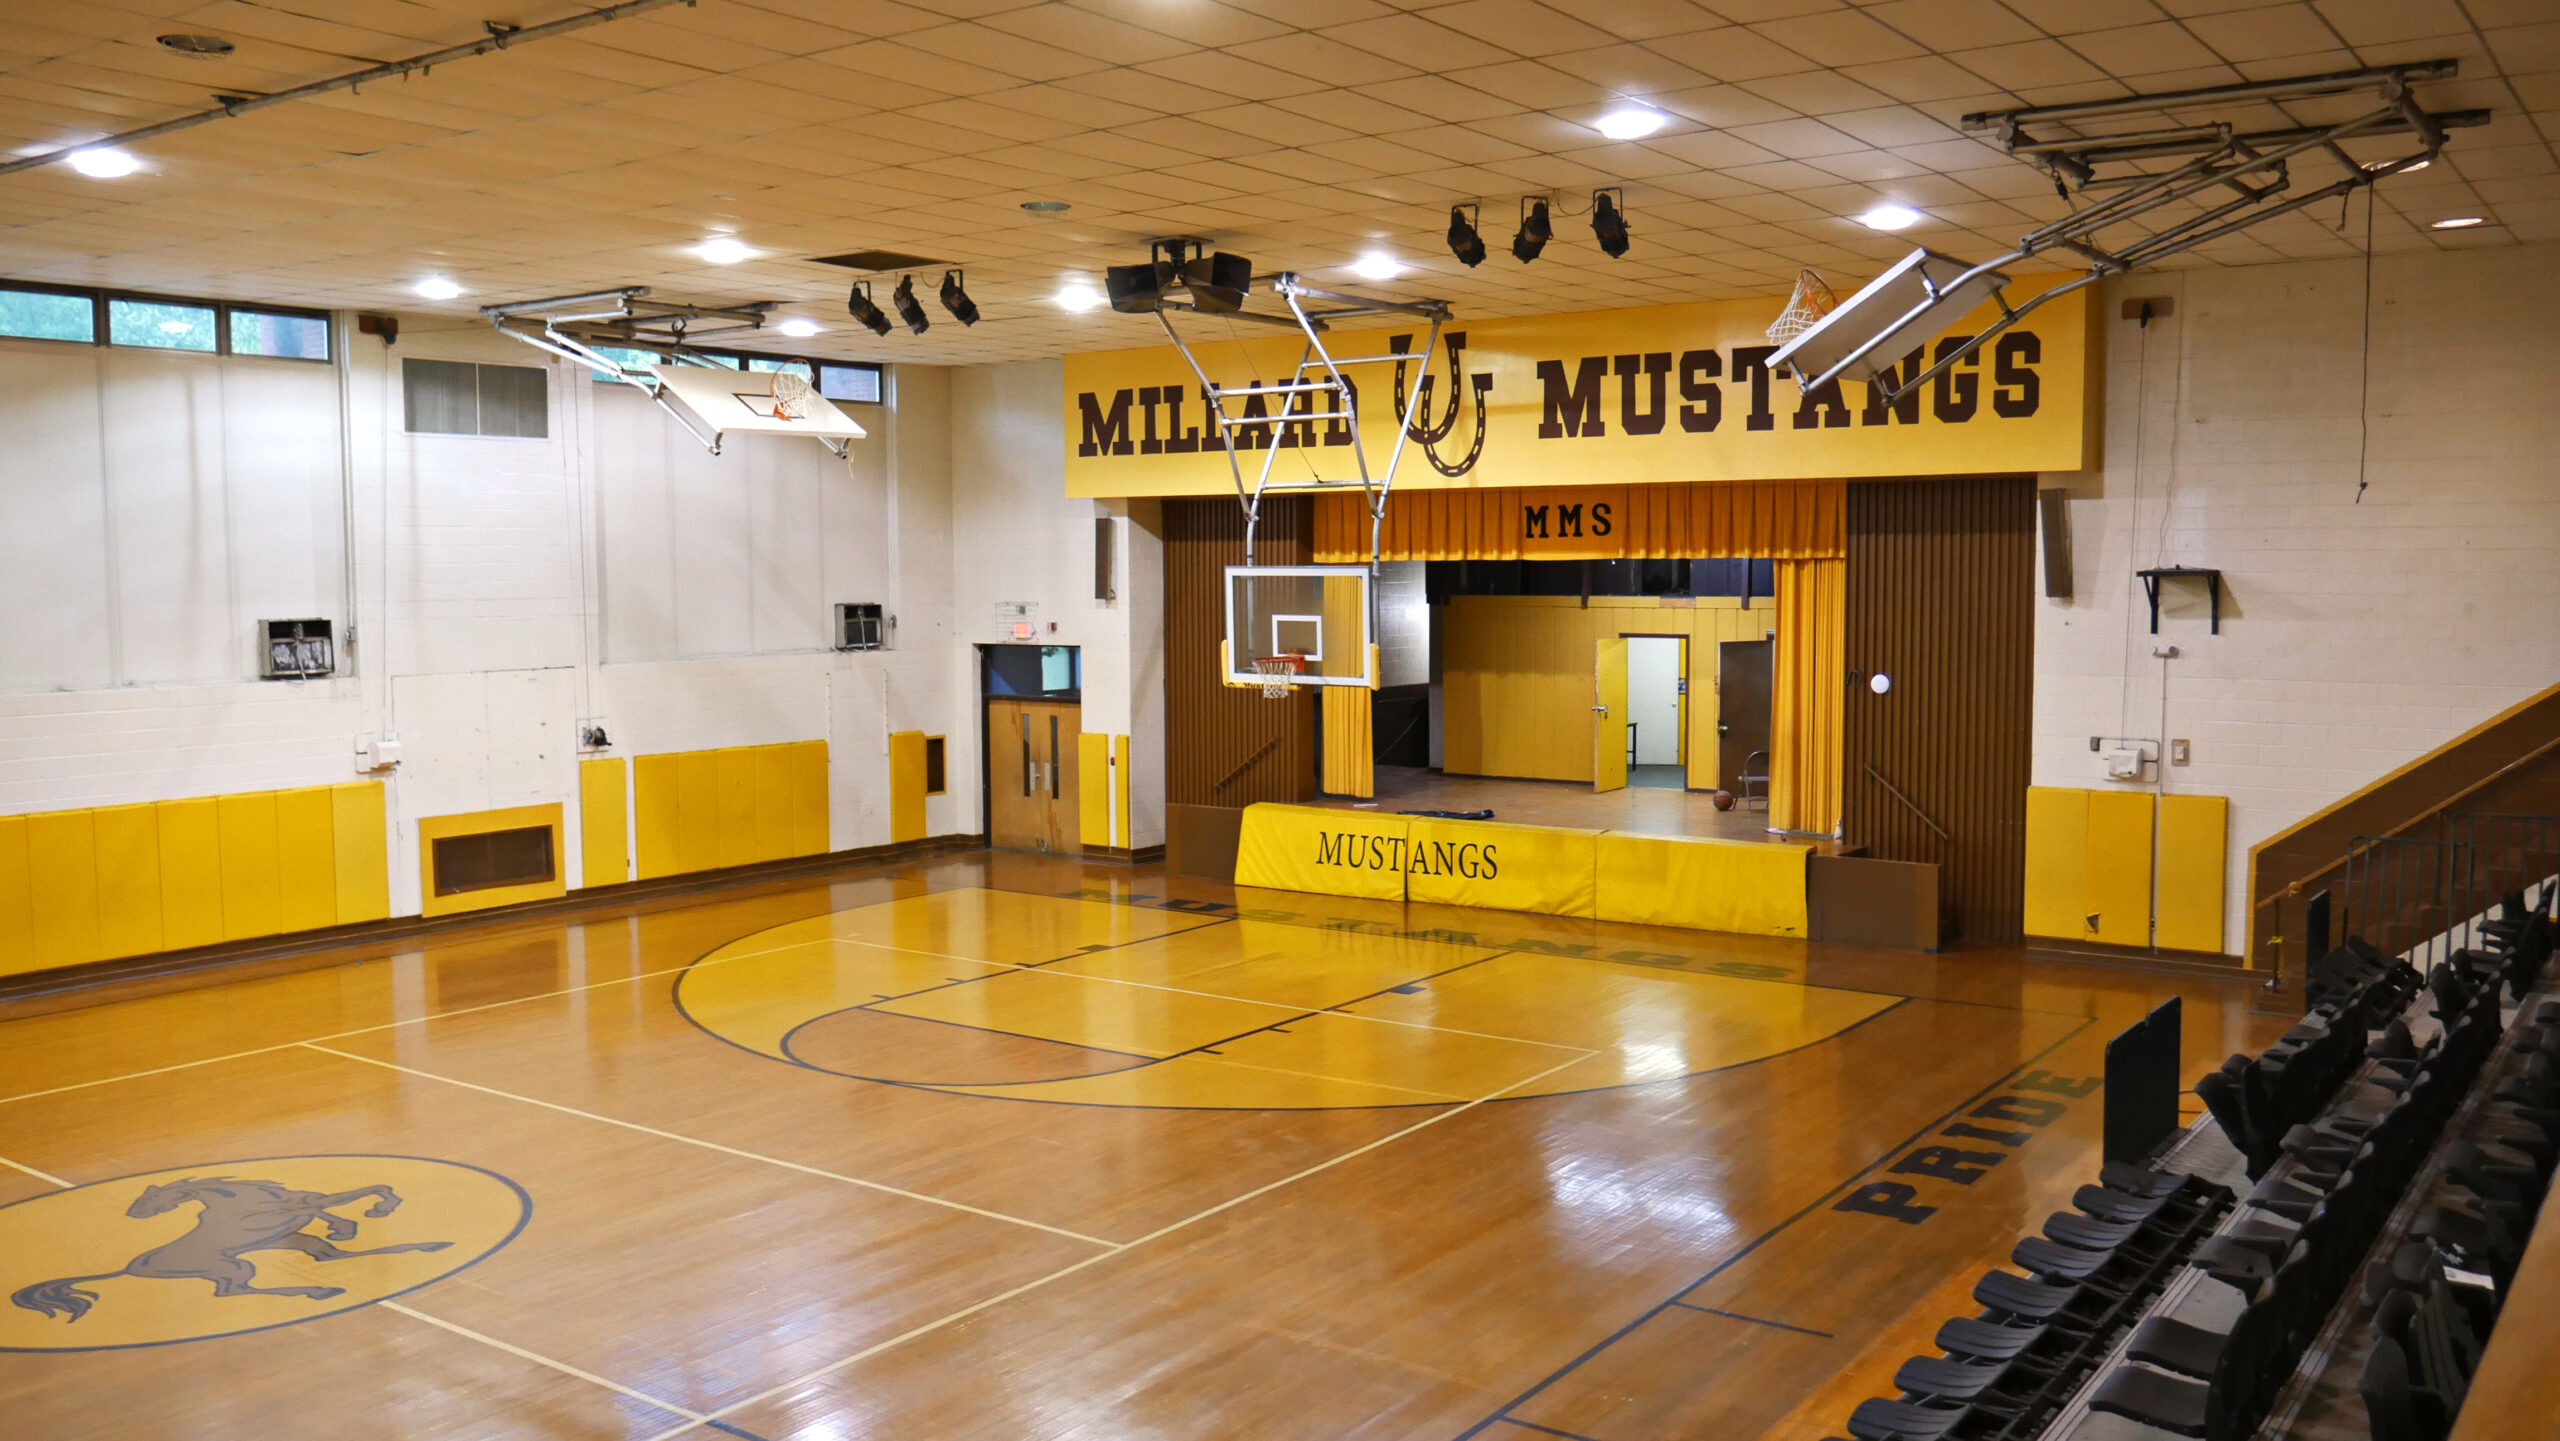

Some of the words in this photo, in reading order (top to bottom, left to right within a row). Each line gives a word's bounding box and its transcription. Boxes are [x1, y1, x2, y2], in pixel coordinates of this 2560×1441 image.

[1078, 373, 1358, 457] MILLARD
[1536, 331, 2042, 439] MUSTANGS
[1524, 503, 1613, 539] MMS
[1315, 832, 1499, 880] MUSTANGS
[1831, 1069, 2104, 1225] PRIDE
